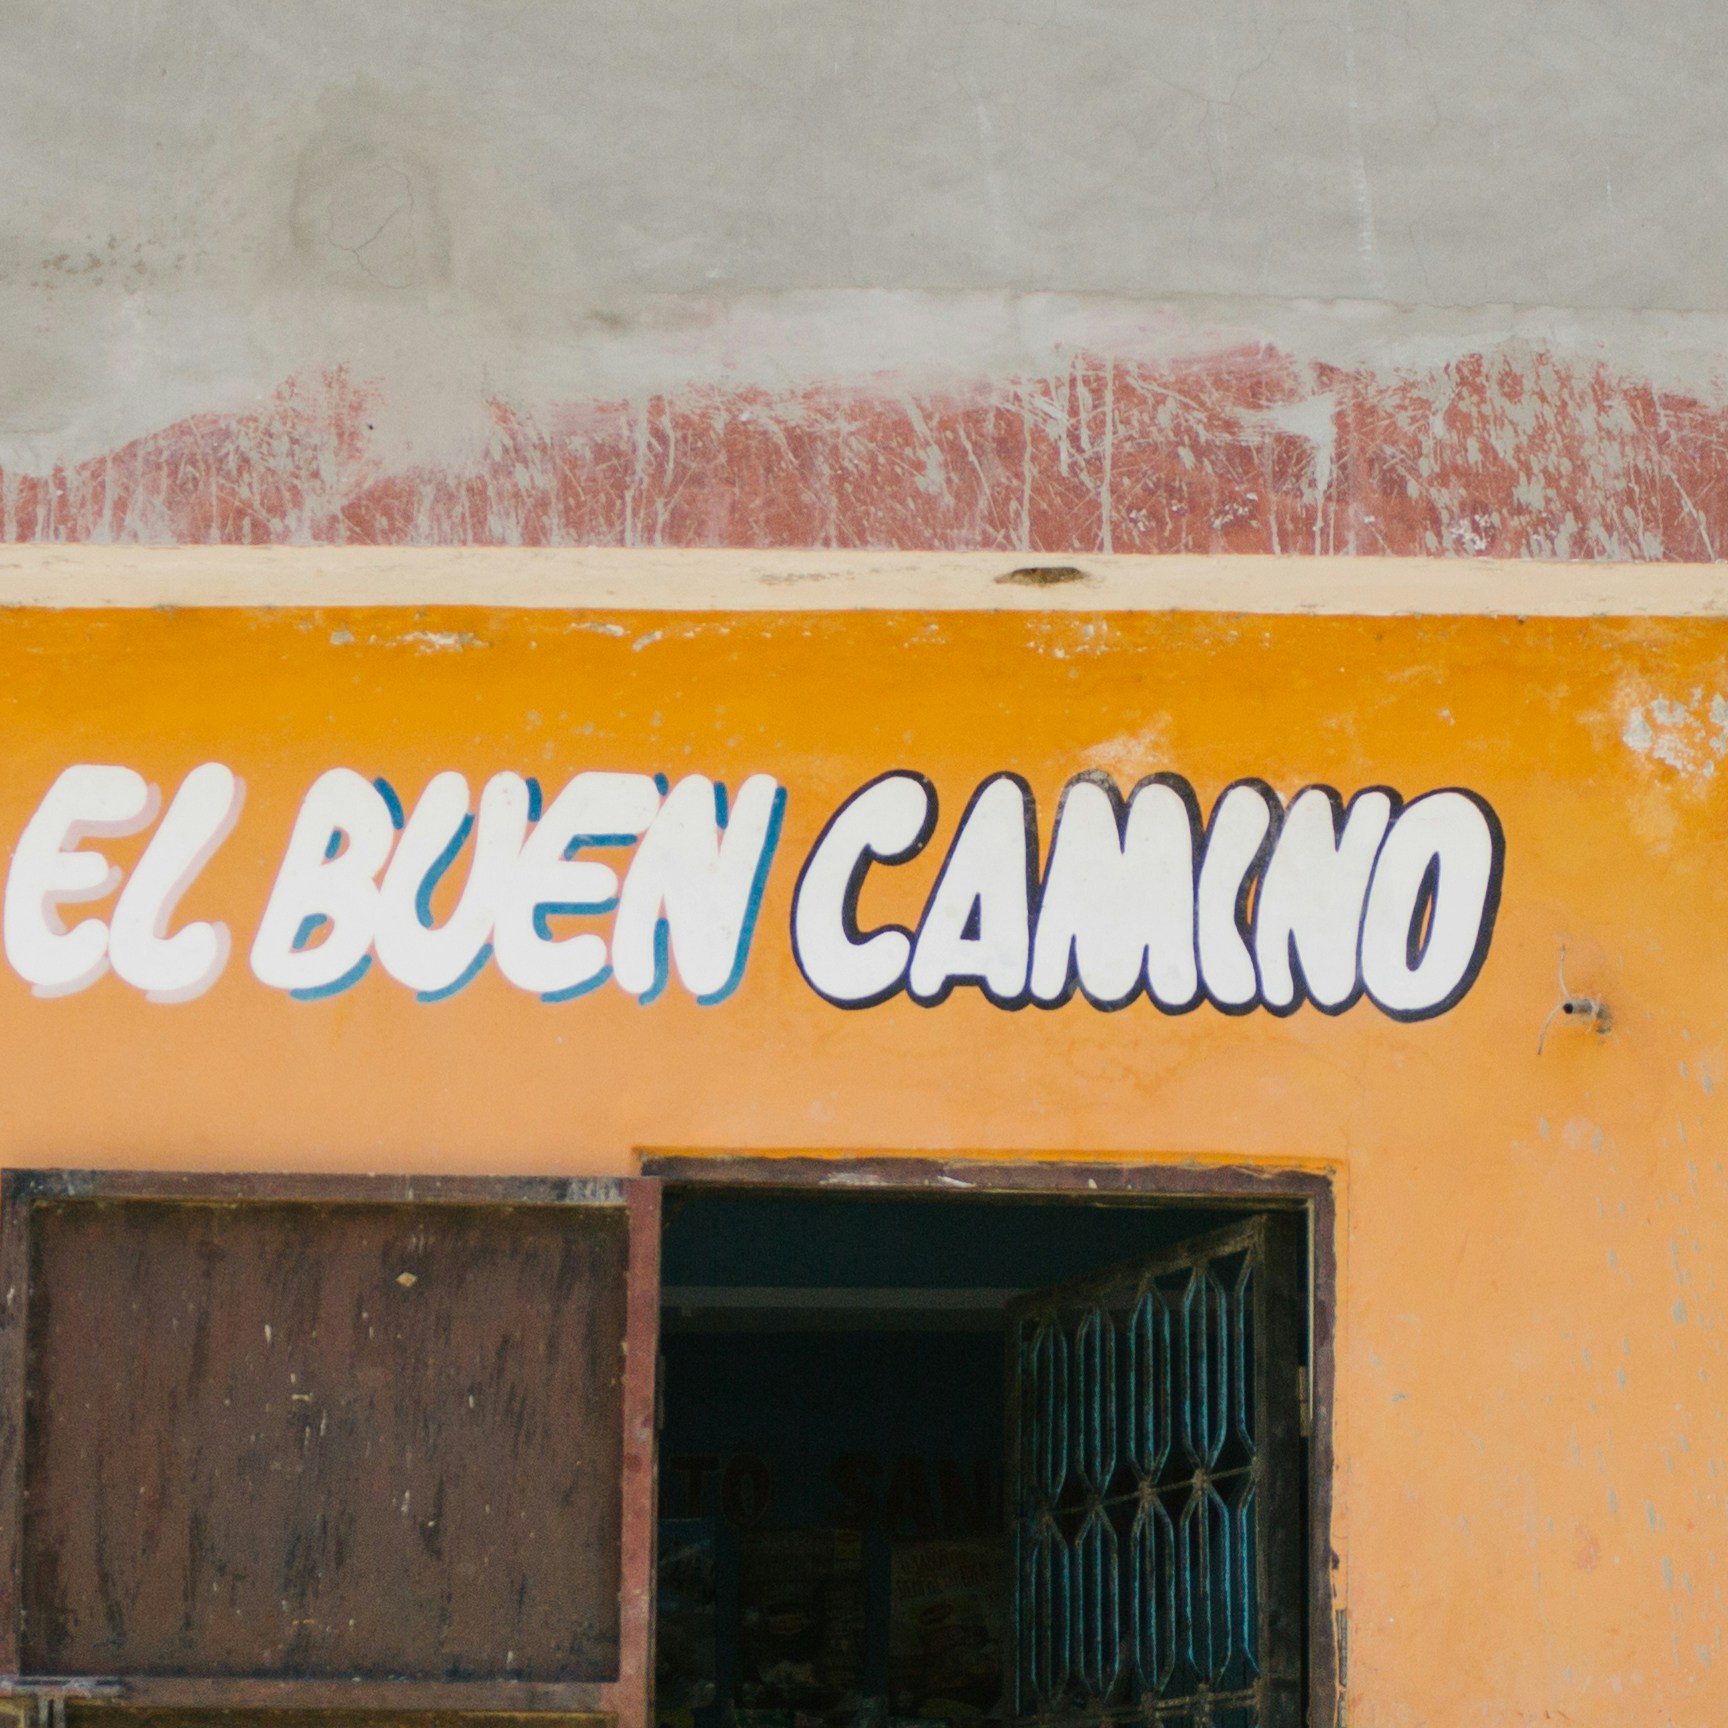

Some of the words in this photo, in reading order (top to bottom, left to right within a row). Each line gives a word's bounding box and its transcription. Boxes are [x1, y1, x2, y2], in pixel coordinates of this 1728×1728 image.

[4, 762, 246, 1004] EL
[250, 768, 788, 1006] BUEN
[791, 769, 1506, 1022] CAMINO
